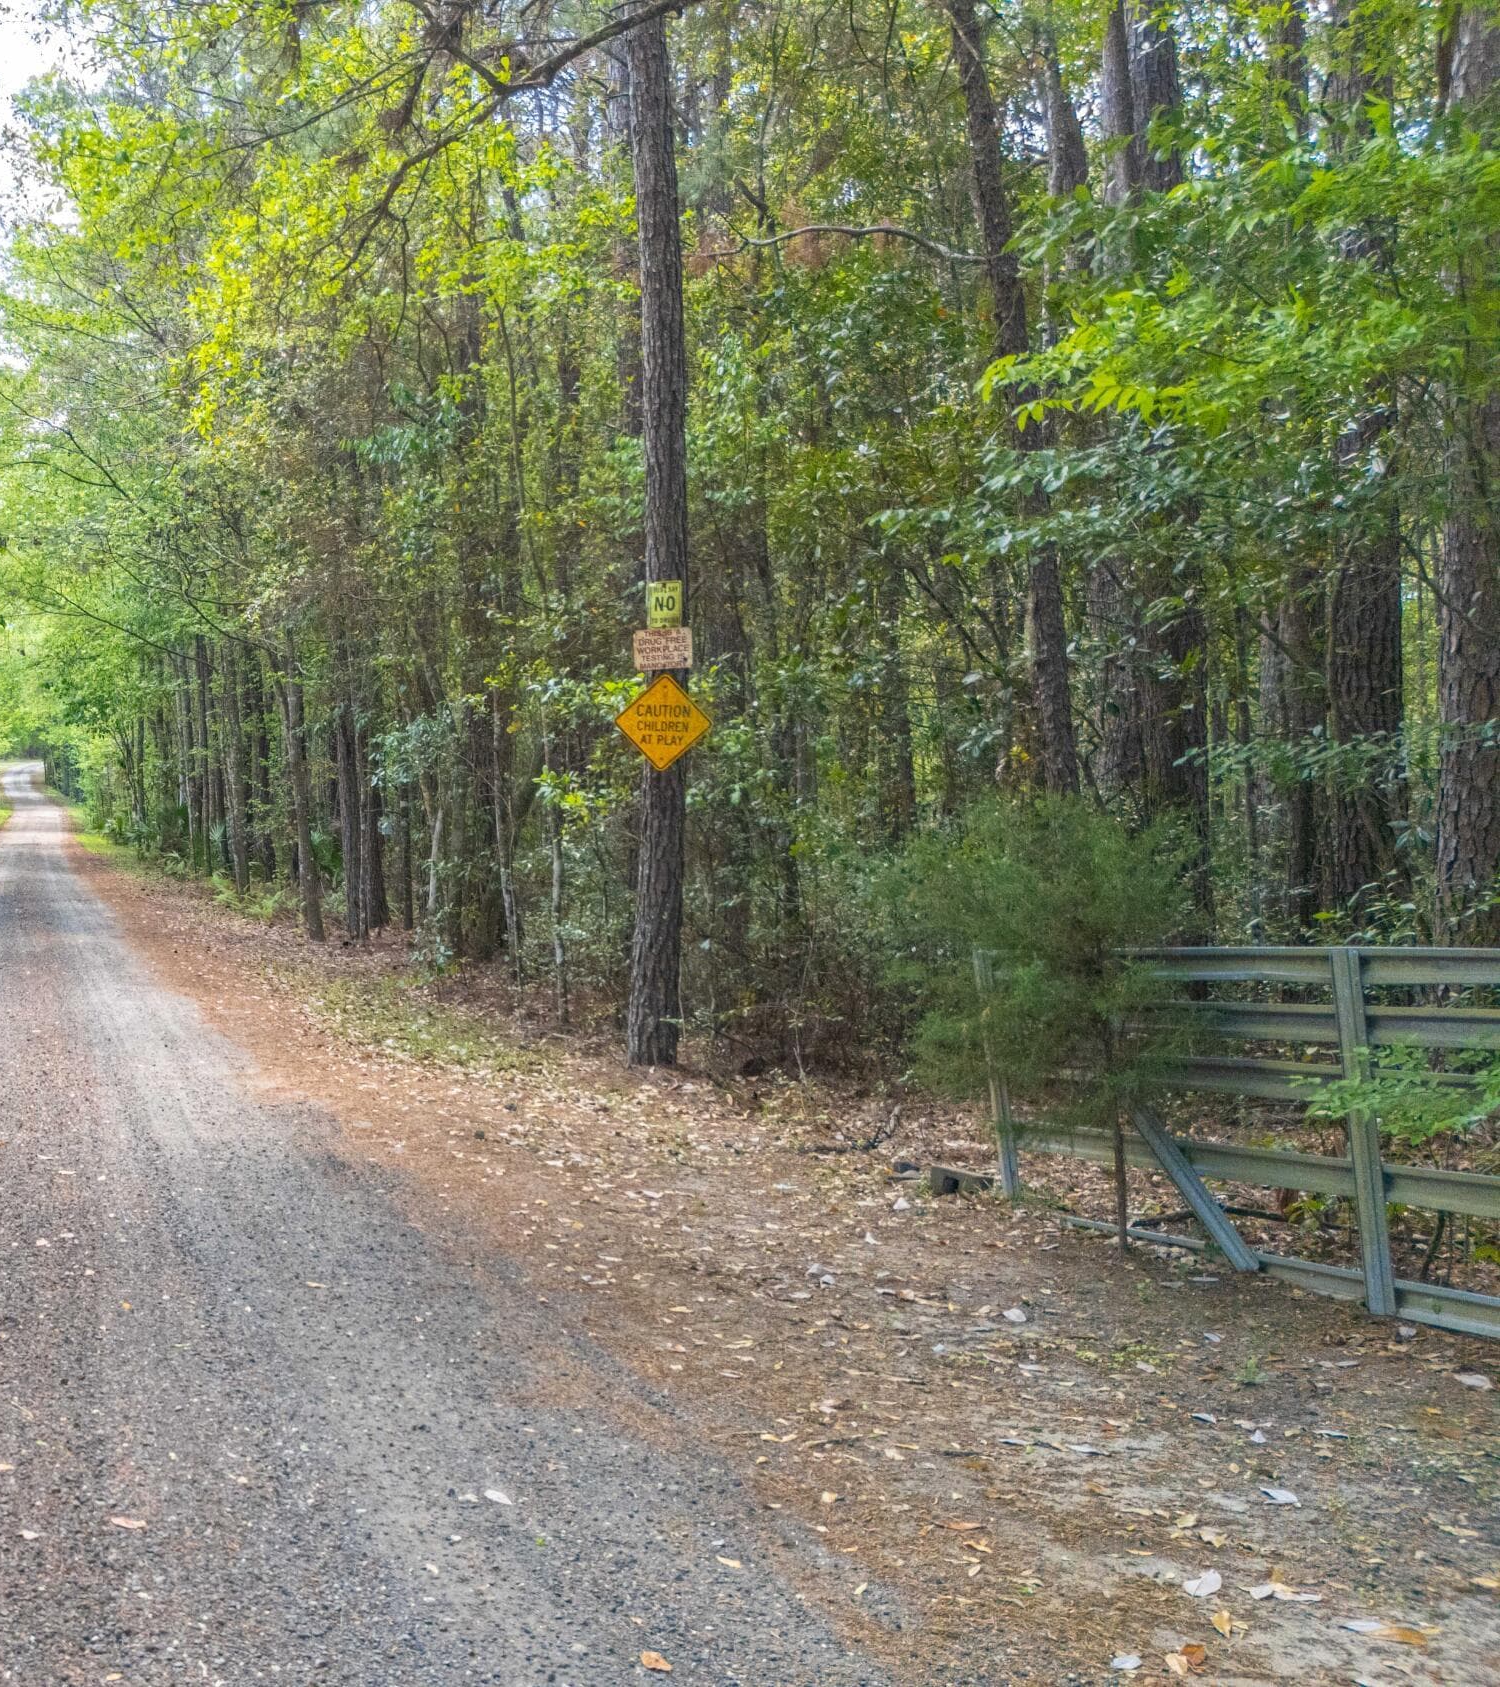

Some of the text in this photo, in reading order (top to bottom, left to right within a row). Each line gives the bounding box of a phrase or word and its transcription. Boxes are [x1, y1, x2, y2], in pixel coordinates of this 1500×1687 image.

[654, 595, 676, 612] NO
[644, 629, 663, 637] THIS
[638, 636, 687, 646] DRUG FREE
[642, 654, 675, 662] TESTING
[636, 704, 691, 718] CAUTION
[636, 720, 689, 732] CHILDREN
[640, 735, 684, 746] AT PLAY
